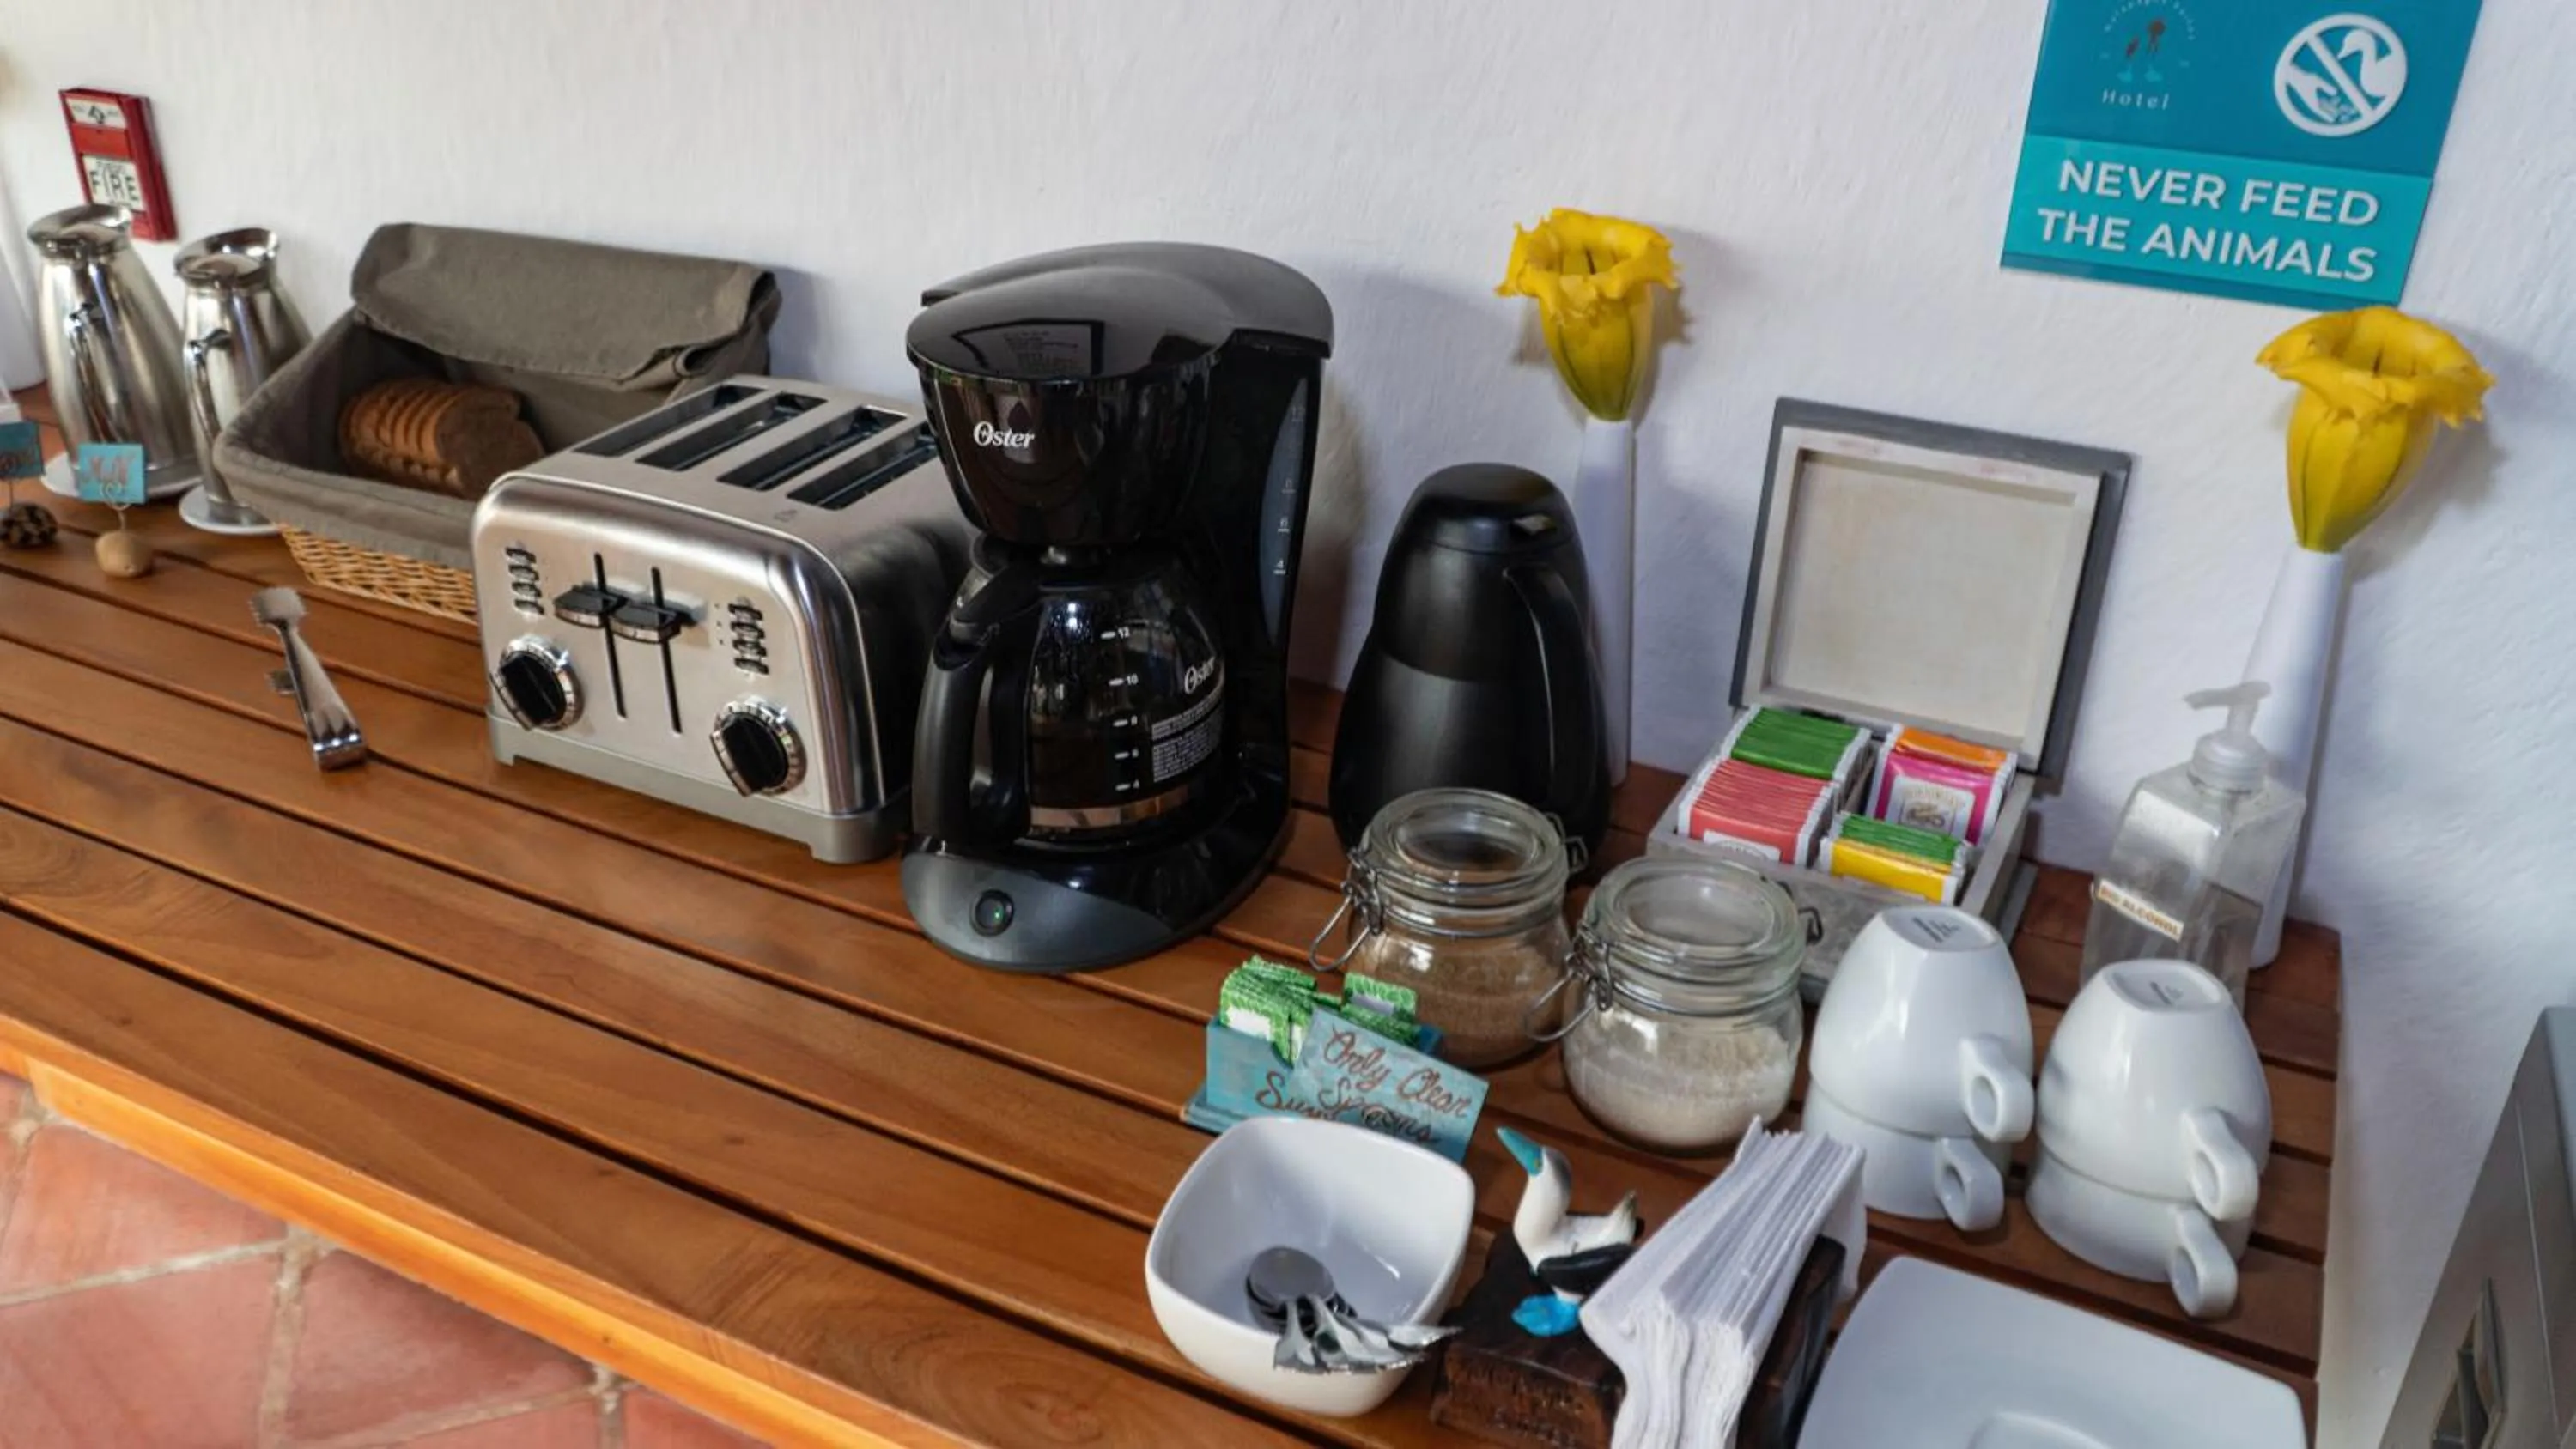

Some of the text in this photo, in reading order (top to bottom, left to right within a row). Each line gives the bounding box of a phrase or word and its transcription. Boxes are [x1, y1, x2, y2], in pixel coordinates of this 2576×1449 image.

[2102, 88, 2170, 111] Hotel
[89, 170, 139, 201] FIRE
[2058, 158, 2379, 227] NEVER FEED
[2037, 208, 2377, 283] THE ANIMALS
[973, 420, 1036, 448] Oster
[1118, 626, 1130, 639] 12
[1126, 673, 1139, 685] 10
[1184, 656, 1216, 695] Oster
[1324, 1023, 1392, 1092] Only
